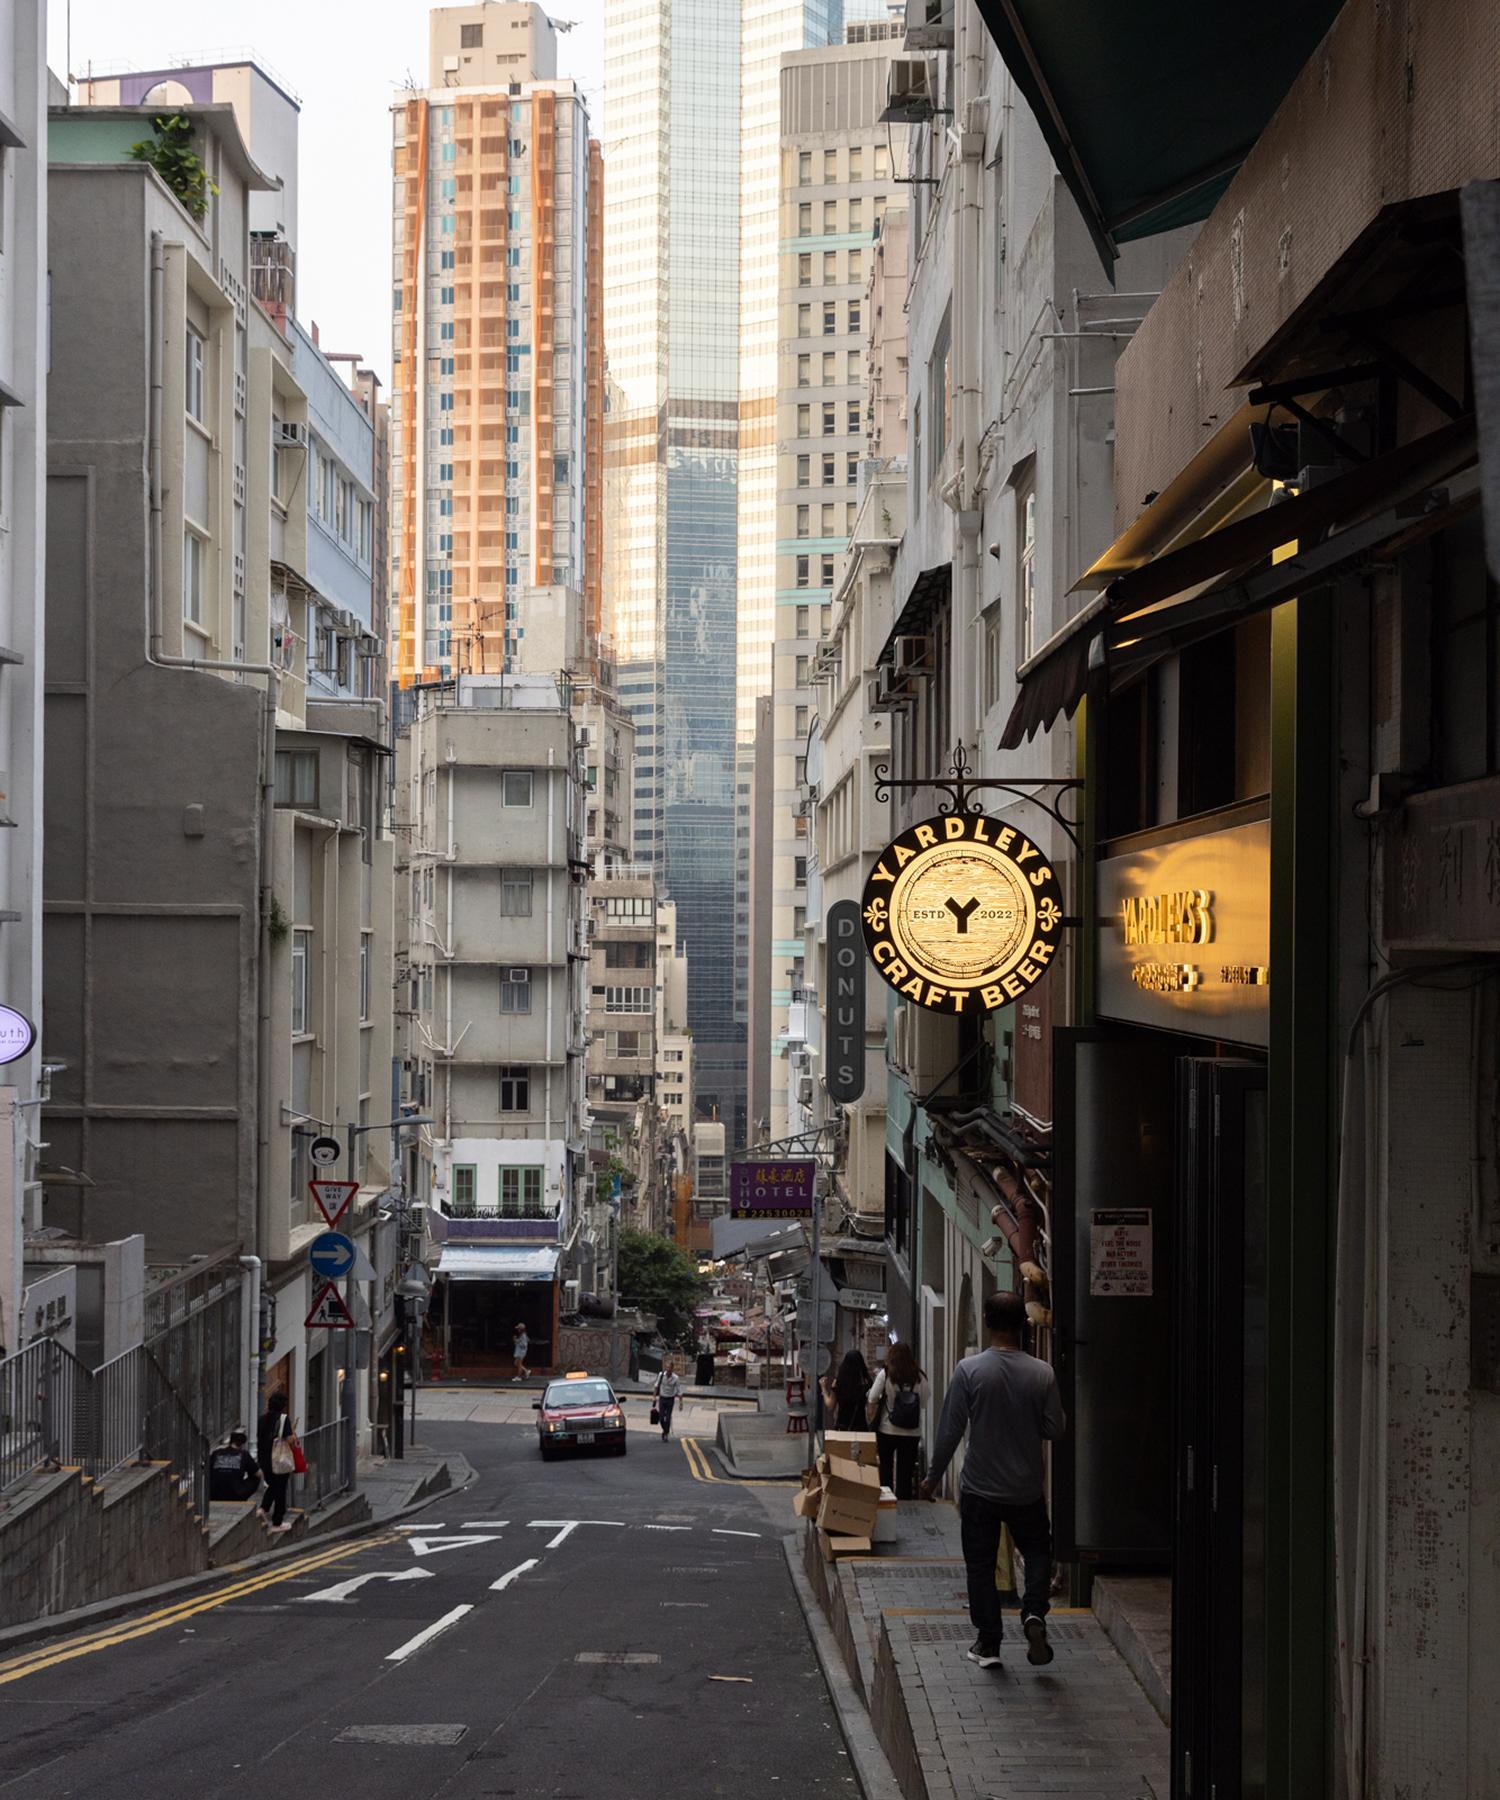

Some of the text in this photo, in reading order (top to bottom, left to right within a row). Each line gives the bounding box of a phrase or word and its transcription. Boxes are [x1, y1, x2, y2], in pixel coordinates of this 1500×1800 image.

[871, 816, 1052, 887] YARDLEYS
[913, 896, 1013, 934] ESTD Y 2022
[1122, 889, 1211, 945] YARDLEYS
[837, 919, 856, 1084] DONUTS
[873, 941, 970, 1012] CRAFT
[980, 938, 1055, 1010] BEER
